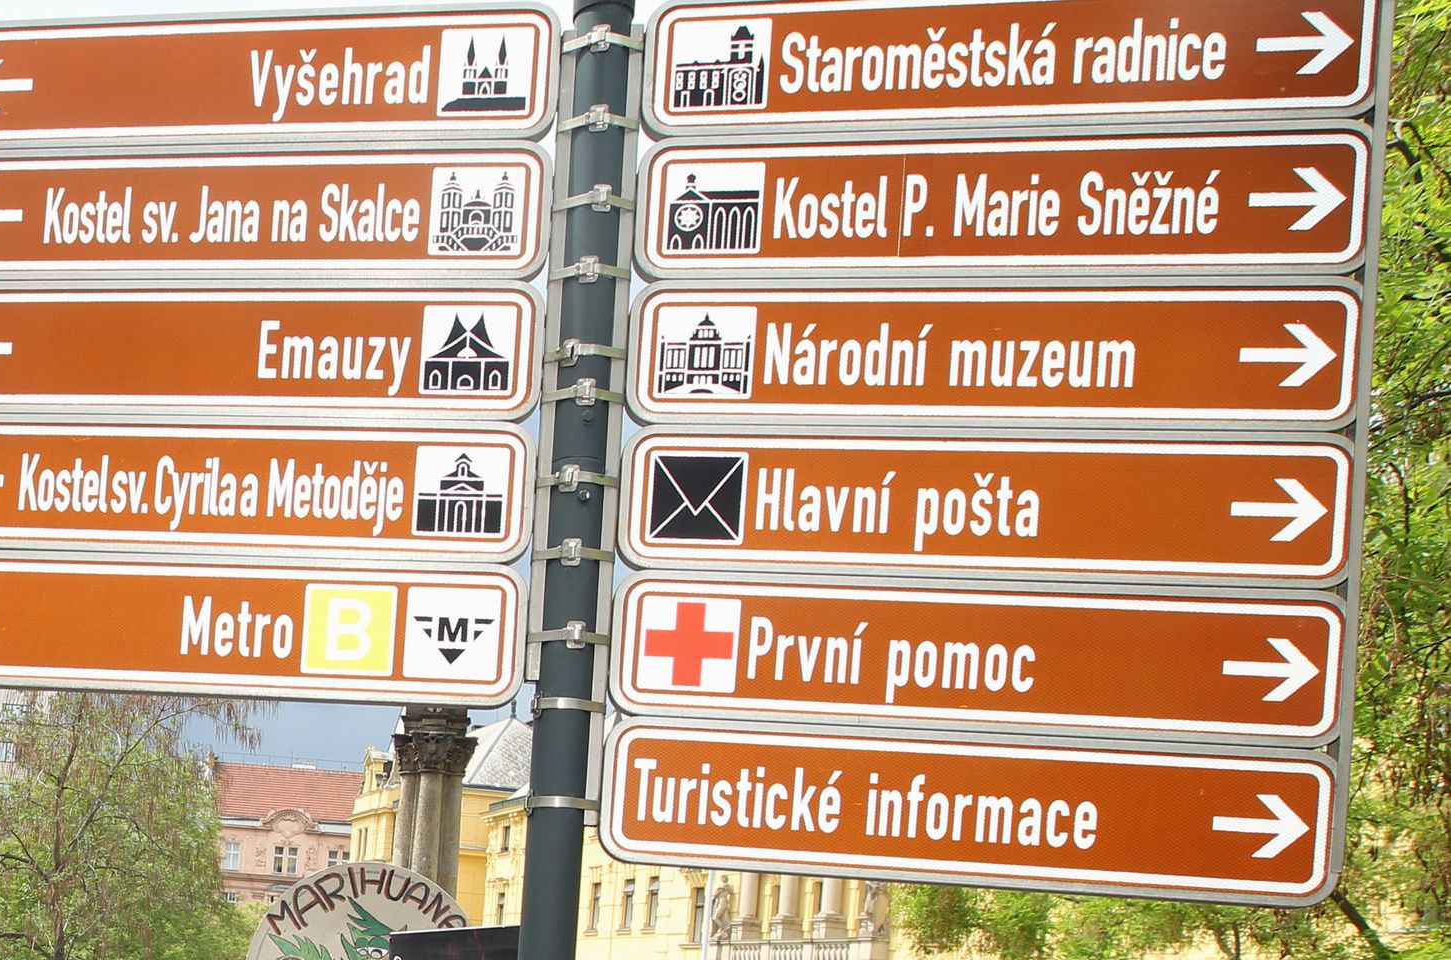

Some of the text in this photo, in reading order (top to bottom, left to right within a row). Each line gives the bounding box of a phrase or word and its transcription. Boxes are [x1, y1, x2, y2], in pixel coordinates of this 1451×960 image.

[251, 45, 431, 122] Vyšehrad
[780, 18, 1226, 93] Staroměstská radnice
[43, 183, 420, 244] Kostel sv. Jana na Skalce
[773, 170, 1220, 239] Kostel P. Marie Sněžné
[258, 320, 411, 396] Emauzy
[764, 323, 1135, 387] Národní muzeum
[267, 458, 404, 536] Metoděje
[755, 468, 1039, 551] Hlavní pošta
[181, 596, 294, 658] Metro
[323, 597, 373, 661] B
[747, 616, 1035, 703] První pomoc
[634, 758, 1097, 849] Turistické informace
